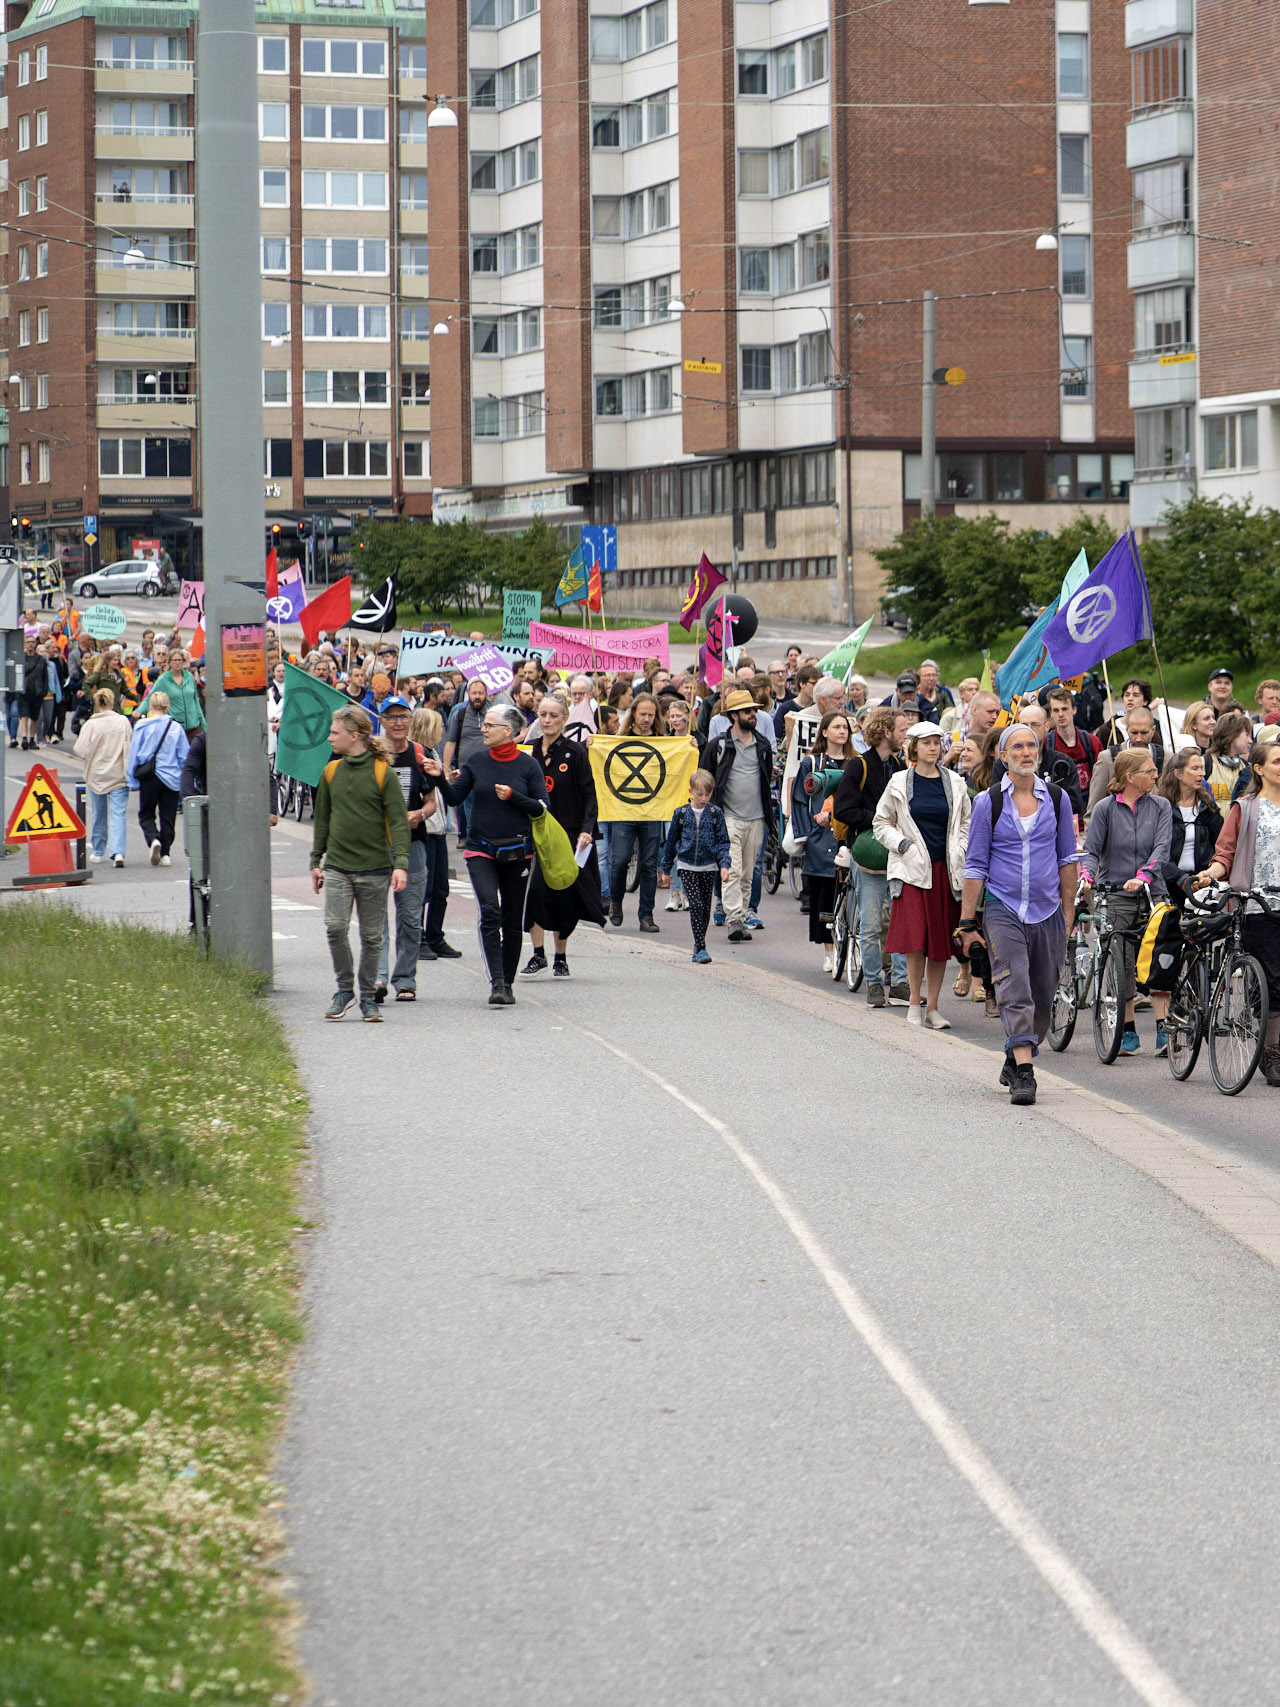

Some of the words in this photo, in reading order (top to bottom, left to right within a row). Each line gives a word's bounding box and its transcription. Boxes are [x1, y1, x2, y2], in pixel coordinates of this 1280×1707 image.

[507, 593, 536, 607] STOPPA
[510, 608, 526, 616] ALLA
[607, 640, 629, 650] GER
[630, 637, 662, 650] STORA
